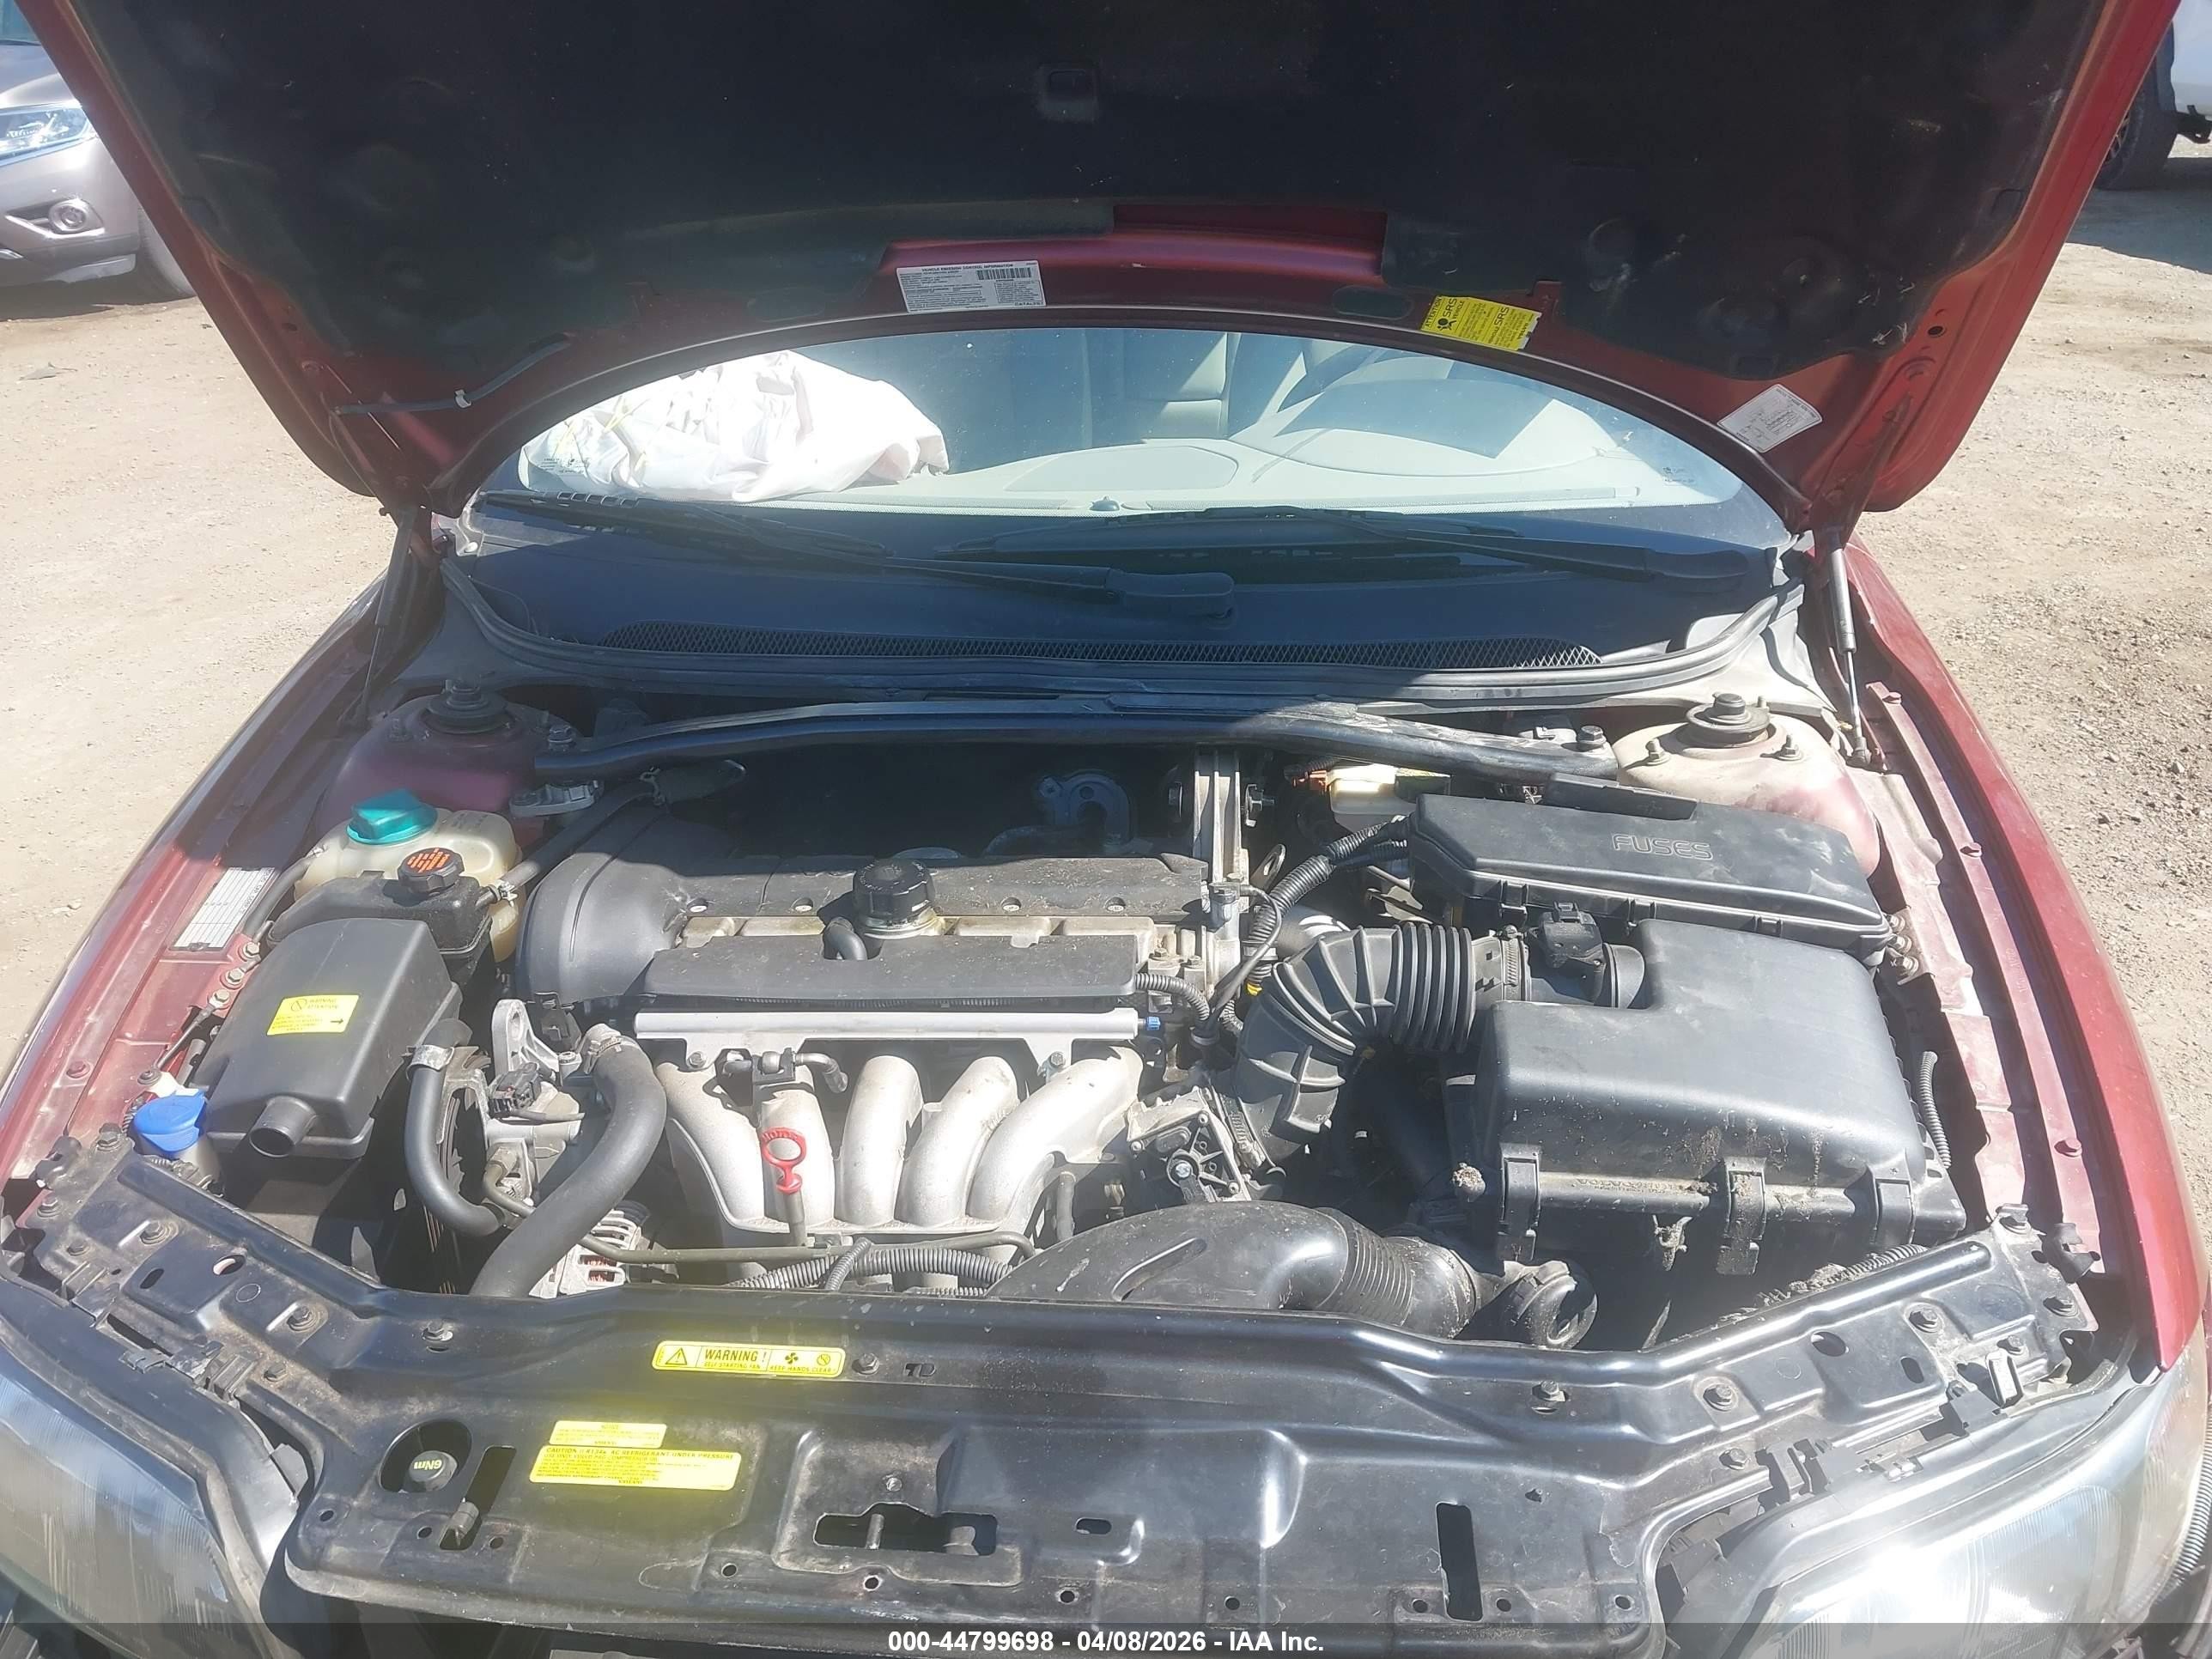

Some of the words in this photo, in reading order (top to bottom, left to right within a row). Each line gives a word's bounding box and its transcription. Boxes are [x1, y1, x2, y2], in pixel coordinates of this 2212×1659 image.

[1443, 297, 1458, 318] SRS
[1493, 306, 1510, 326] SRS
[1612, 833, 1714, 860] FUSES
[704, 1348, 759, 1362] WARNING
[413, 1459, 443, 1471] 6Nm
